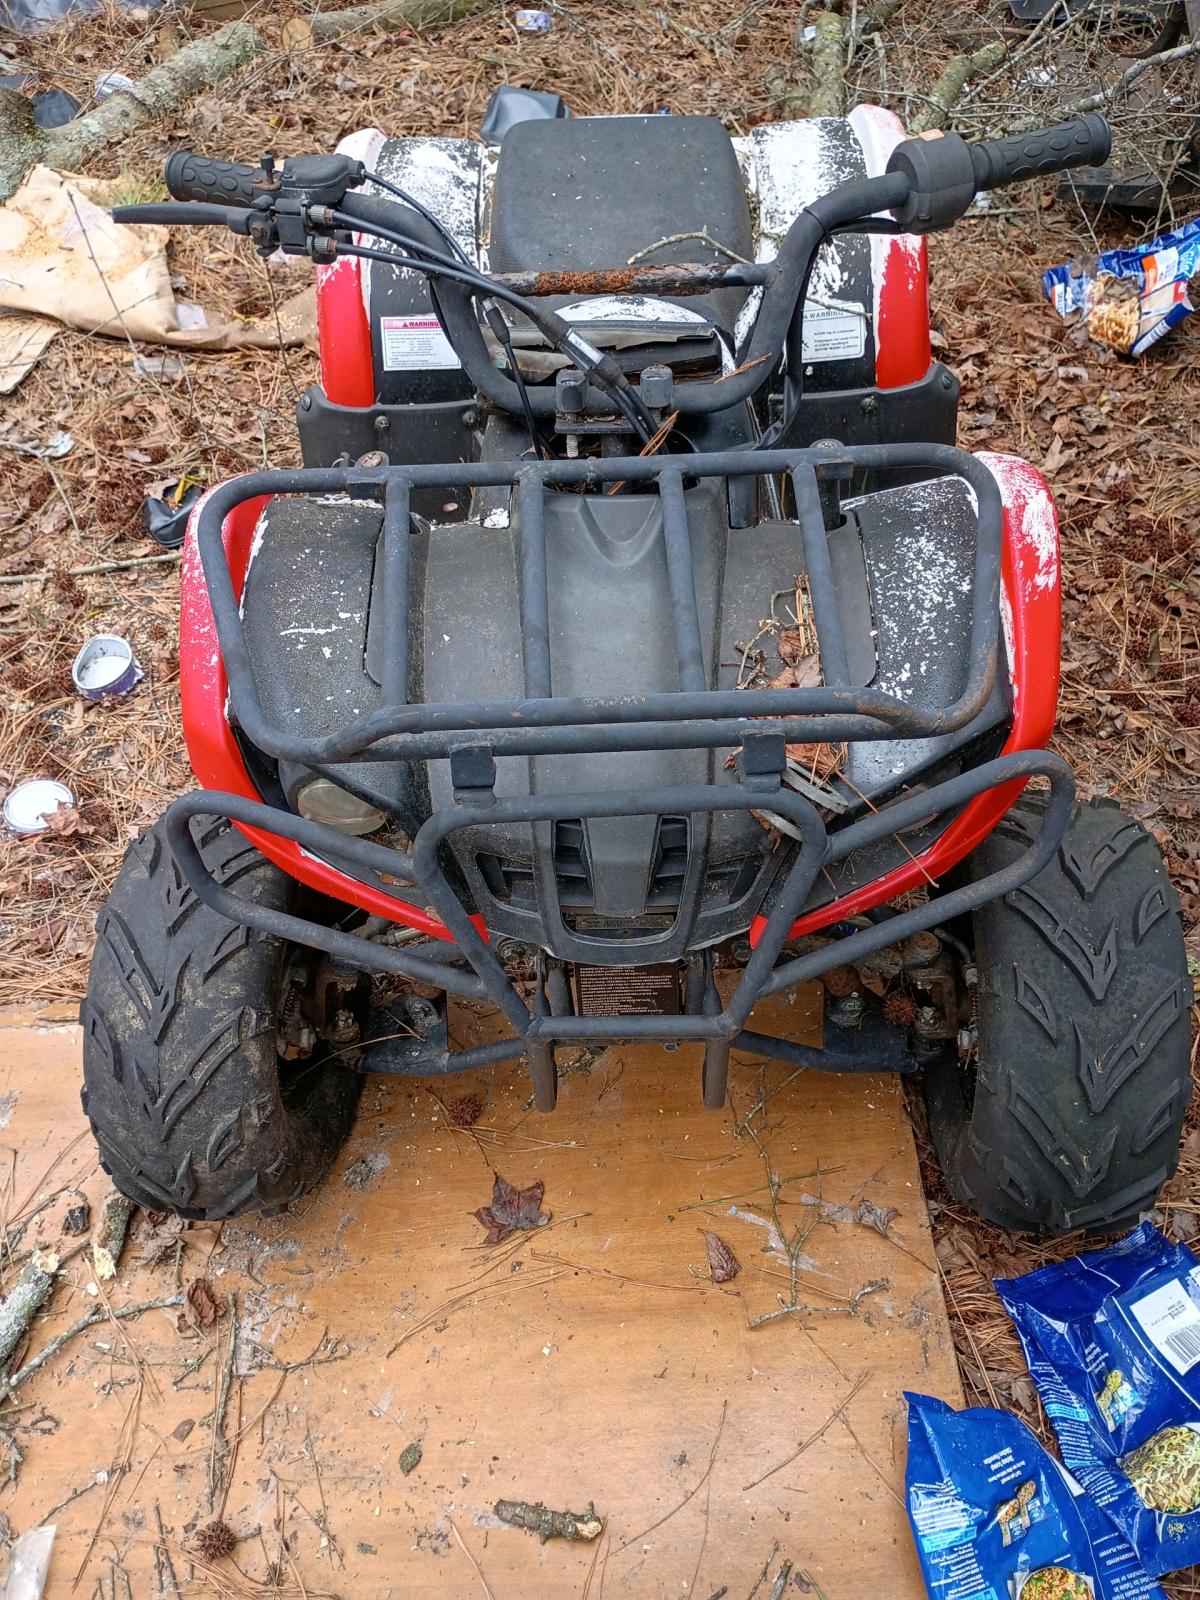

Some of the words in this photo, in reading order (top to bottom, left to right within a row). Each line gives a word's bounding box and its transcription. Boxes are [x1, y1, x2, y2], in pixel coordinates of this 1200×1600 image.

[810, 309, 844, 319] WARNING
[1099, 1547, 1117, 1558] FLAVORS
[1105, 1551, 1136, 1566] RESERVATIVES
[1110, 1578, 1121, 1586] less
[1119, 1582, 1133, 1590] Table
[1139, 1581, 1160, 1592] omplete
[1124, 1588, 1140, 1597] meals
